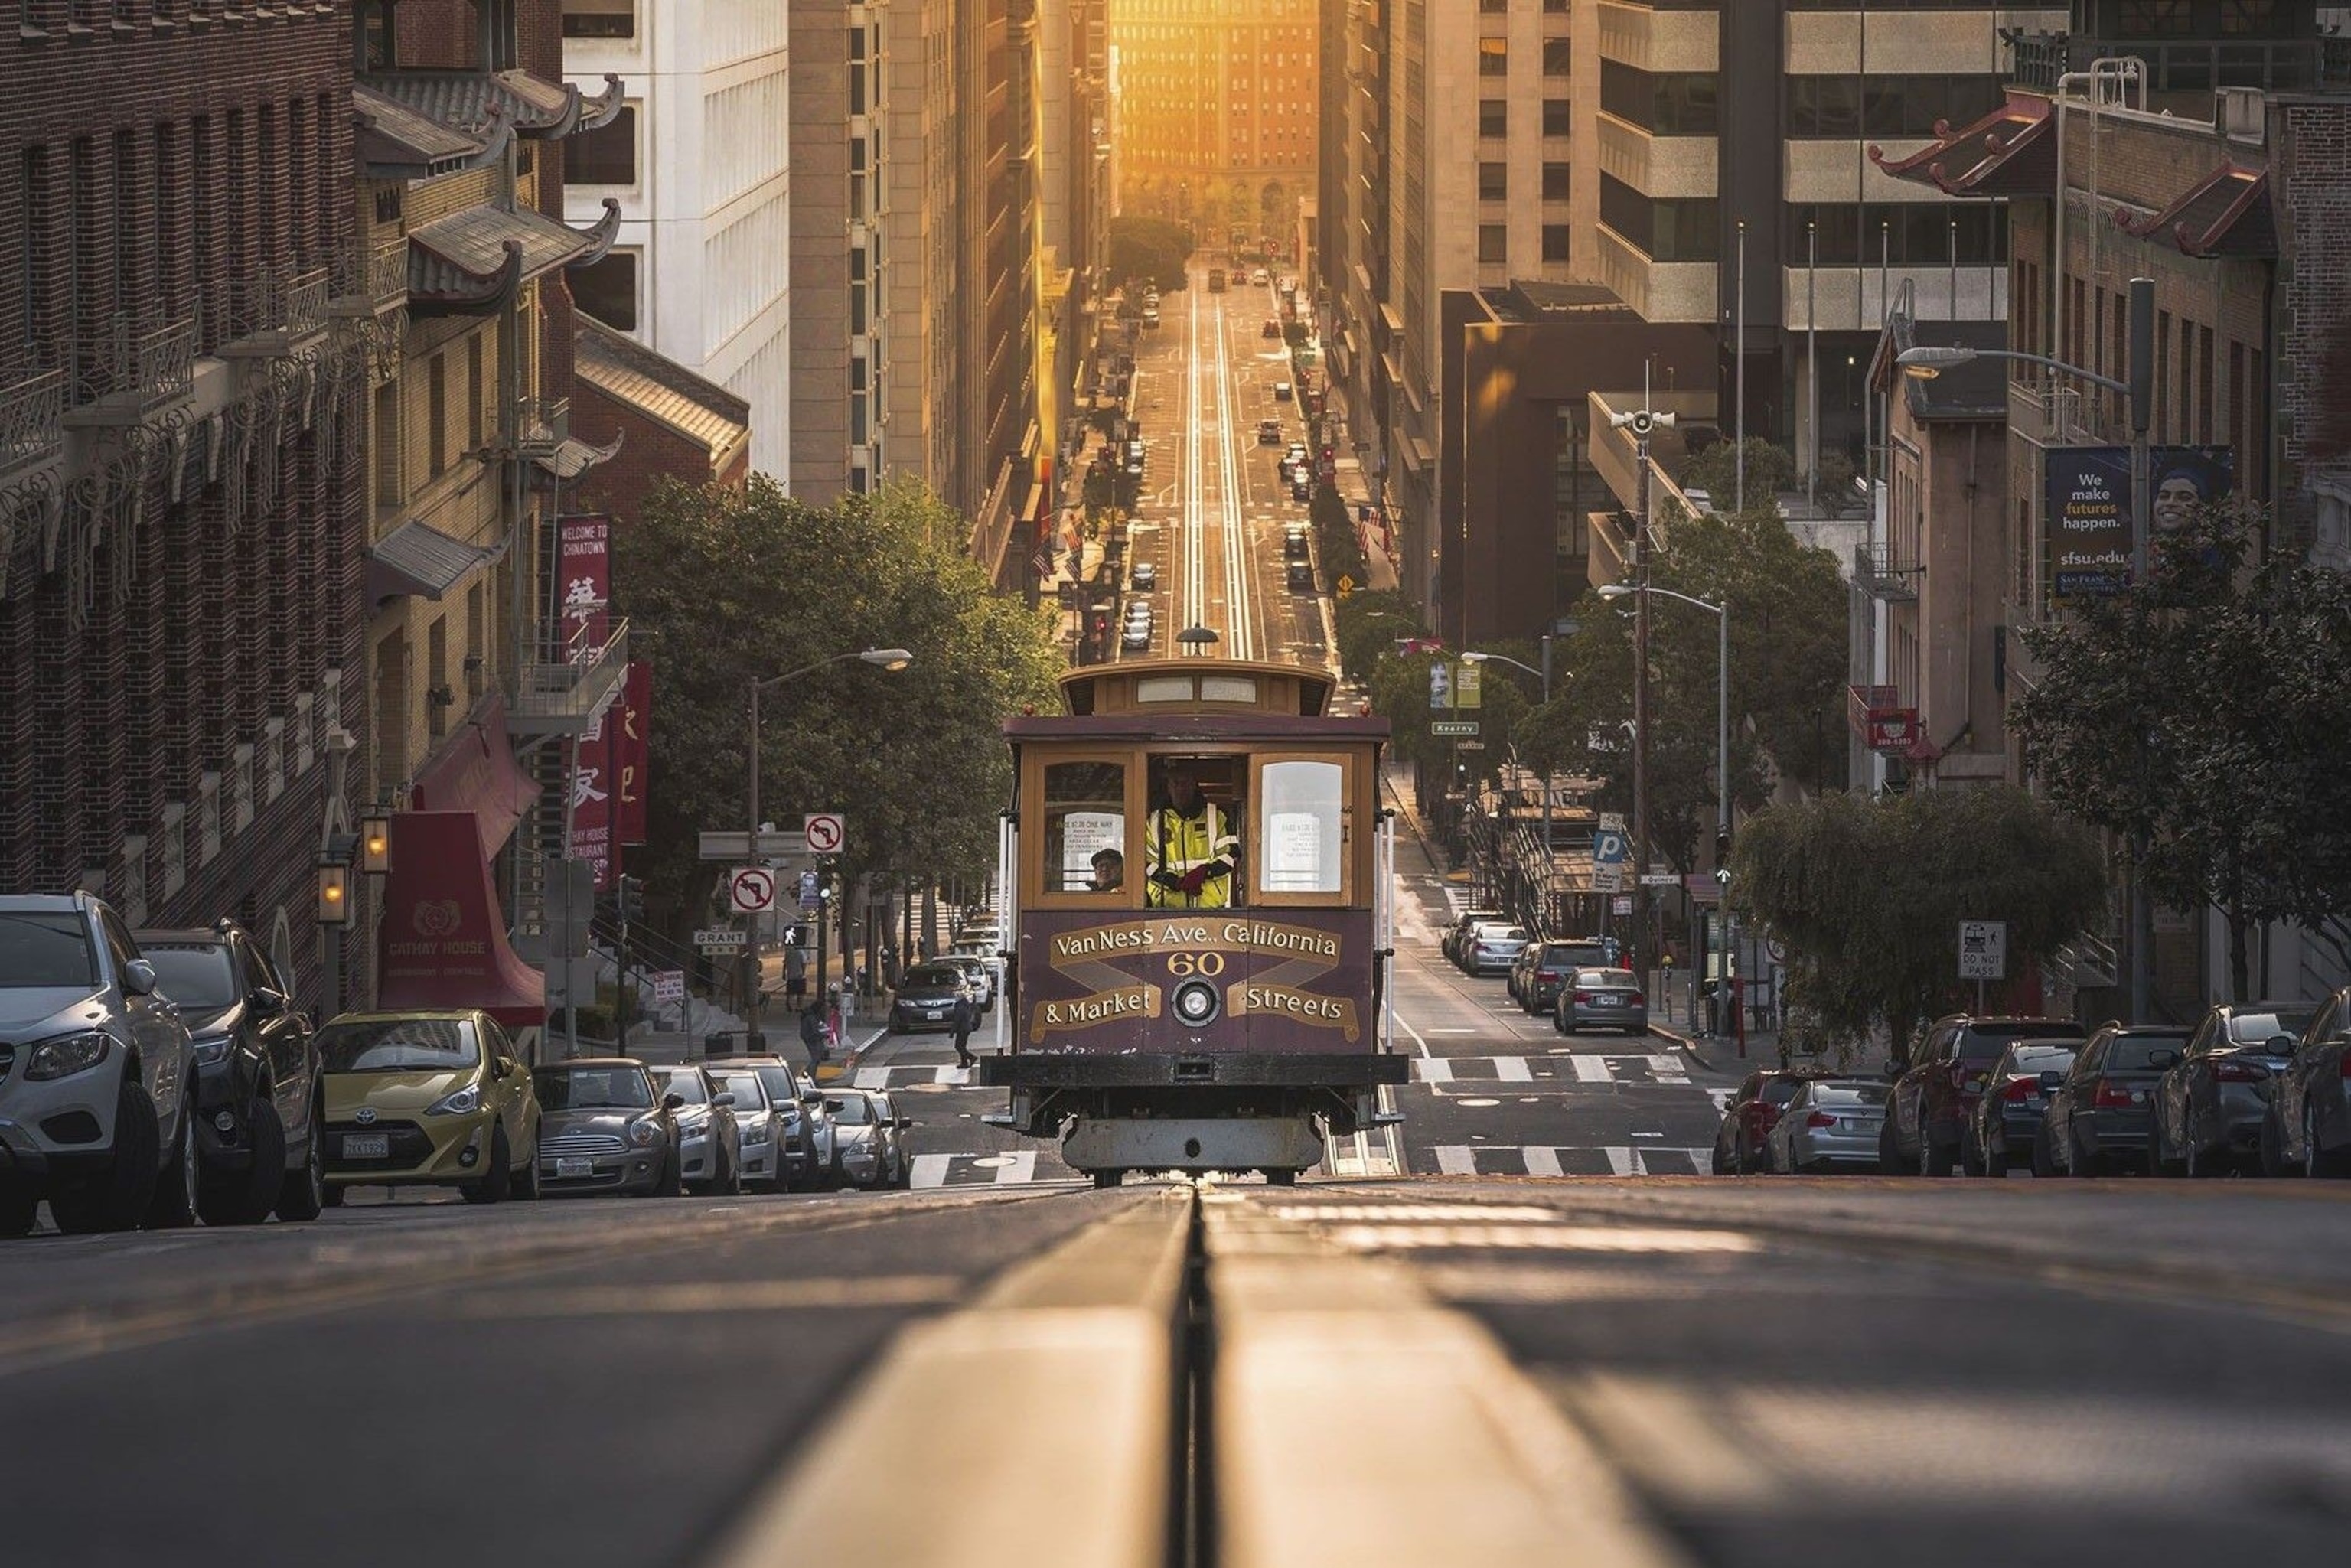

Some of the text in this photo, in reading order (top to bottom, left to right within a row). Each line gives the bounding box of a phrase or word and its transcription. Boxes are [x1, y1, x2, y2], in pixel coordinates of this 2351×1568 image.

[2079, 474, 2102, 486] We
[2072, 487, 2110, 500] make
[2066, 502, 2118, 514] futures
[2062, 517, 2121, 532] happen.
[562, 525, 607, 540] WELCOME TO
[563, 541, 605, 556] CHINATOWN
[2060, 550, 2125, 566] sfsu.edu
[1437, 725, 1473, 733] Kearny
[697, 934, 742, 943] GRANT
[1057, 935, 1096, 958] Van
[1098, 926, 1156, 951] Ness
[1223, 923, 1339, 957] California
[389, 941, 485, 955] CATHAY HOUSE
[1167, 951, 1225, 976] 60
[1964, 954, 2000, 964] DO NOT
[1969, 966, 1994, 975] PASS
[1045, 990, 1150, 1024] & Market
[1247, 987, 1342, 1019] Streets
